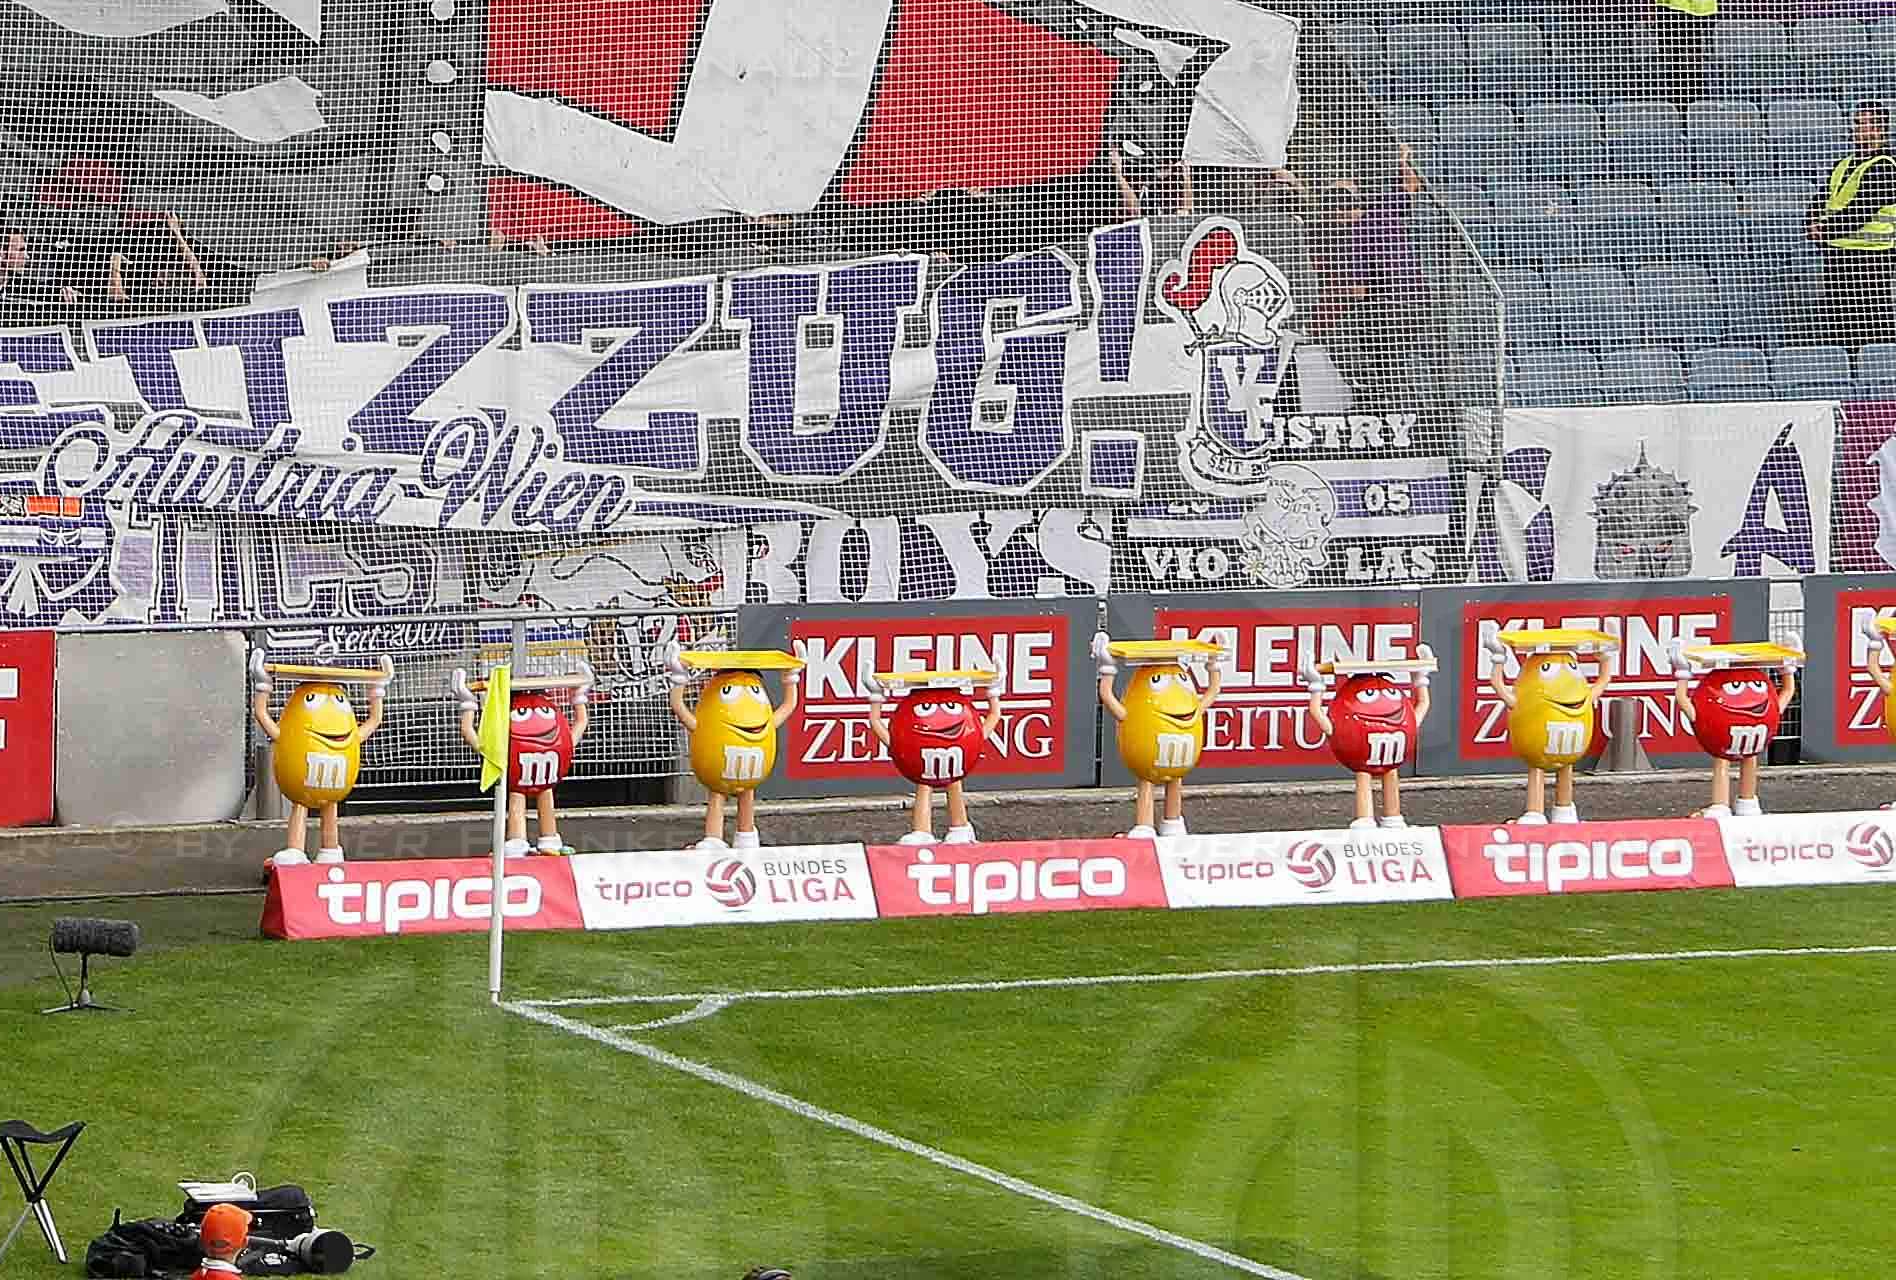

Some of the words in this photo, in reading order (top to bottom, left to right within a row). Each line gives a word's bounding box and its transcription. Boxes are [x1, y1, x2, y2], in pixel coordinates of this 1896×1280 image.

[420, 405, 634, 530] Wien
[1365, 484, 1411, 513] 05
[1154, 733, 1196, 768] m
[1367, 730, 1407, 766] m
[1545, 719, 1586, 755] m
[1727, 724, 1769, 756] m
[306, 751, 347, 788] m
[518, 751, 559, 787] m
[722, 744, 763, 780] m
[920, 746, 963, 780] m
[763, 857, 848, 876] BUNDES
[1341, 841, 1425, 858] BUNDES
[1483, 826, 1693, 892] tipico
[1743, 837, 1835, 866] tipico
[908, 848, 1127, 914] tipico
[1178, 856, 1274, 882] tipico
[1347, 859, 1433, 886] LIGA
[318, 867, 542, 933] tipico
[594, 875, 693, 905] tipico
[769, 878, 856, 903] LIGA
